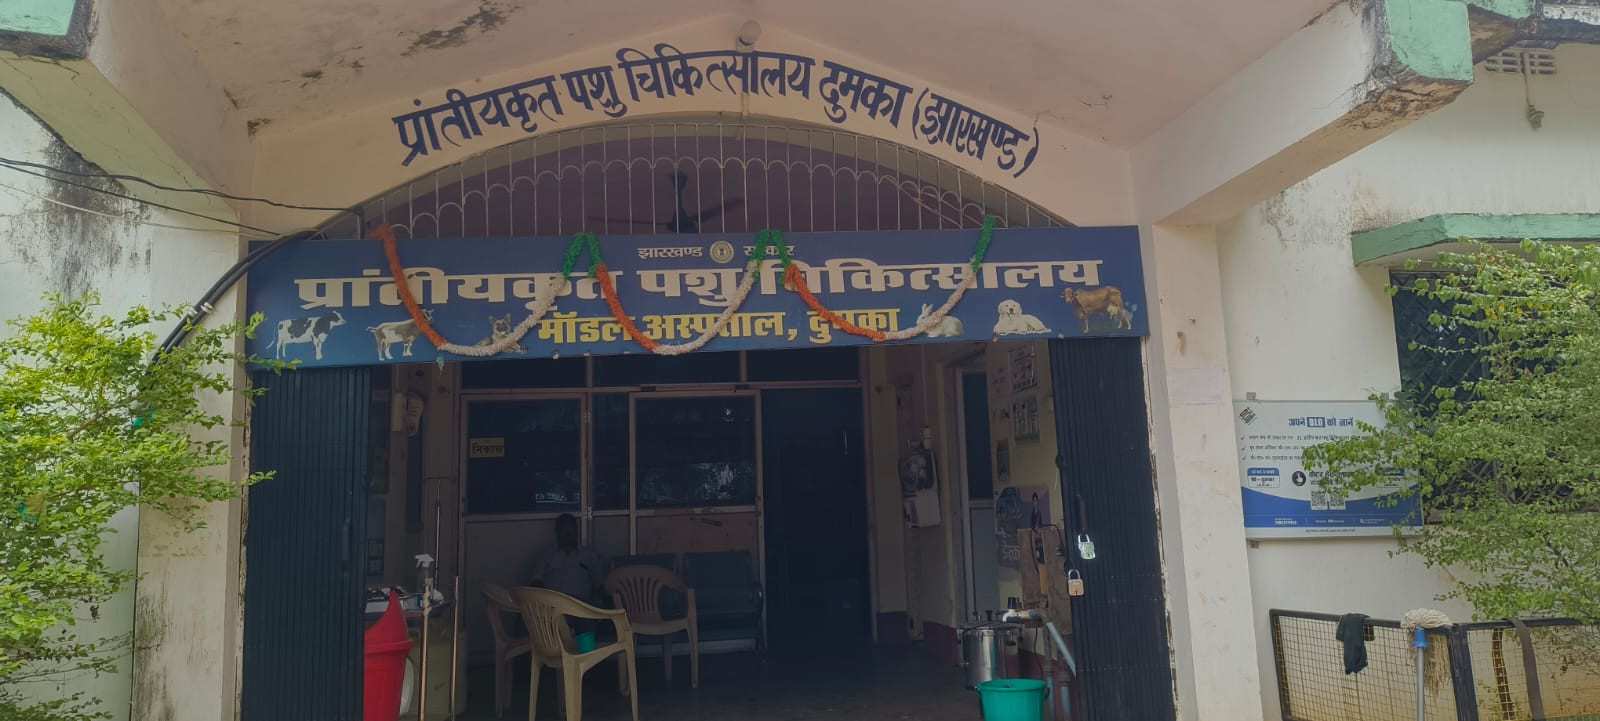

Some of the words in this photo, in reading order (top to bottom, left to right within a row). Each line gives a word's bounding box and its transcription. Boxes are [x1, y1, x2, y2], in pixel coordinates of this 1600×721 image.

[391, 75, 564, 166] प्रांतीयकृत
[560, 65, 627, 117] पशु
[616, 43, 815, 102] चिकित्सालय
[819, 60, 913, 128] दुमका
[636, 247, 703, 259] झारखण्ड
[744, 245, 796, 257] सकर
[636, 268, 743, 307] पशु
[537, 311, 635, 343] मॉडल
